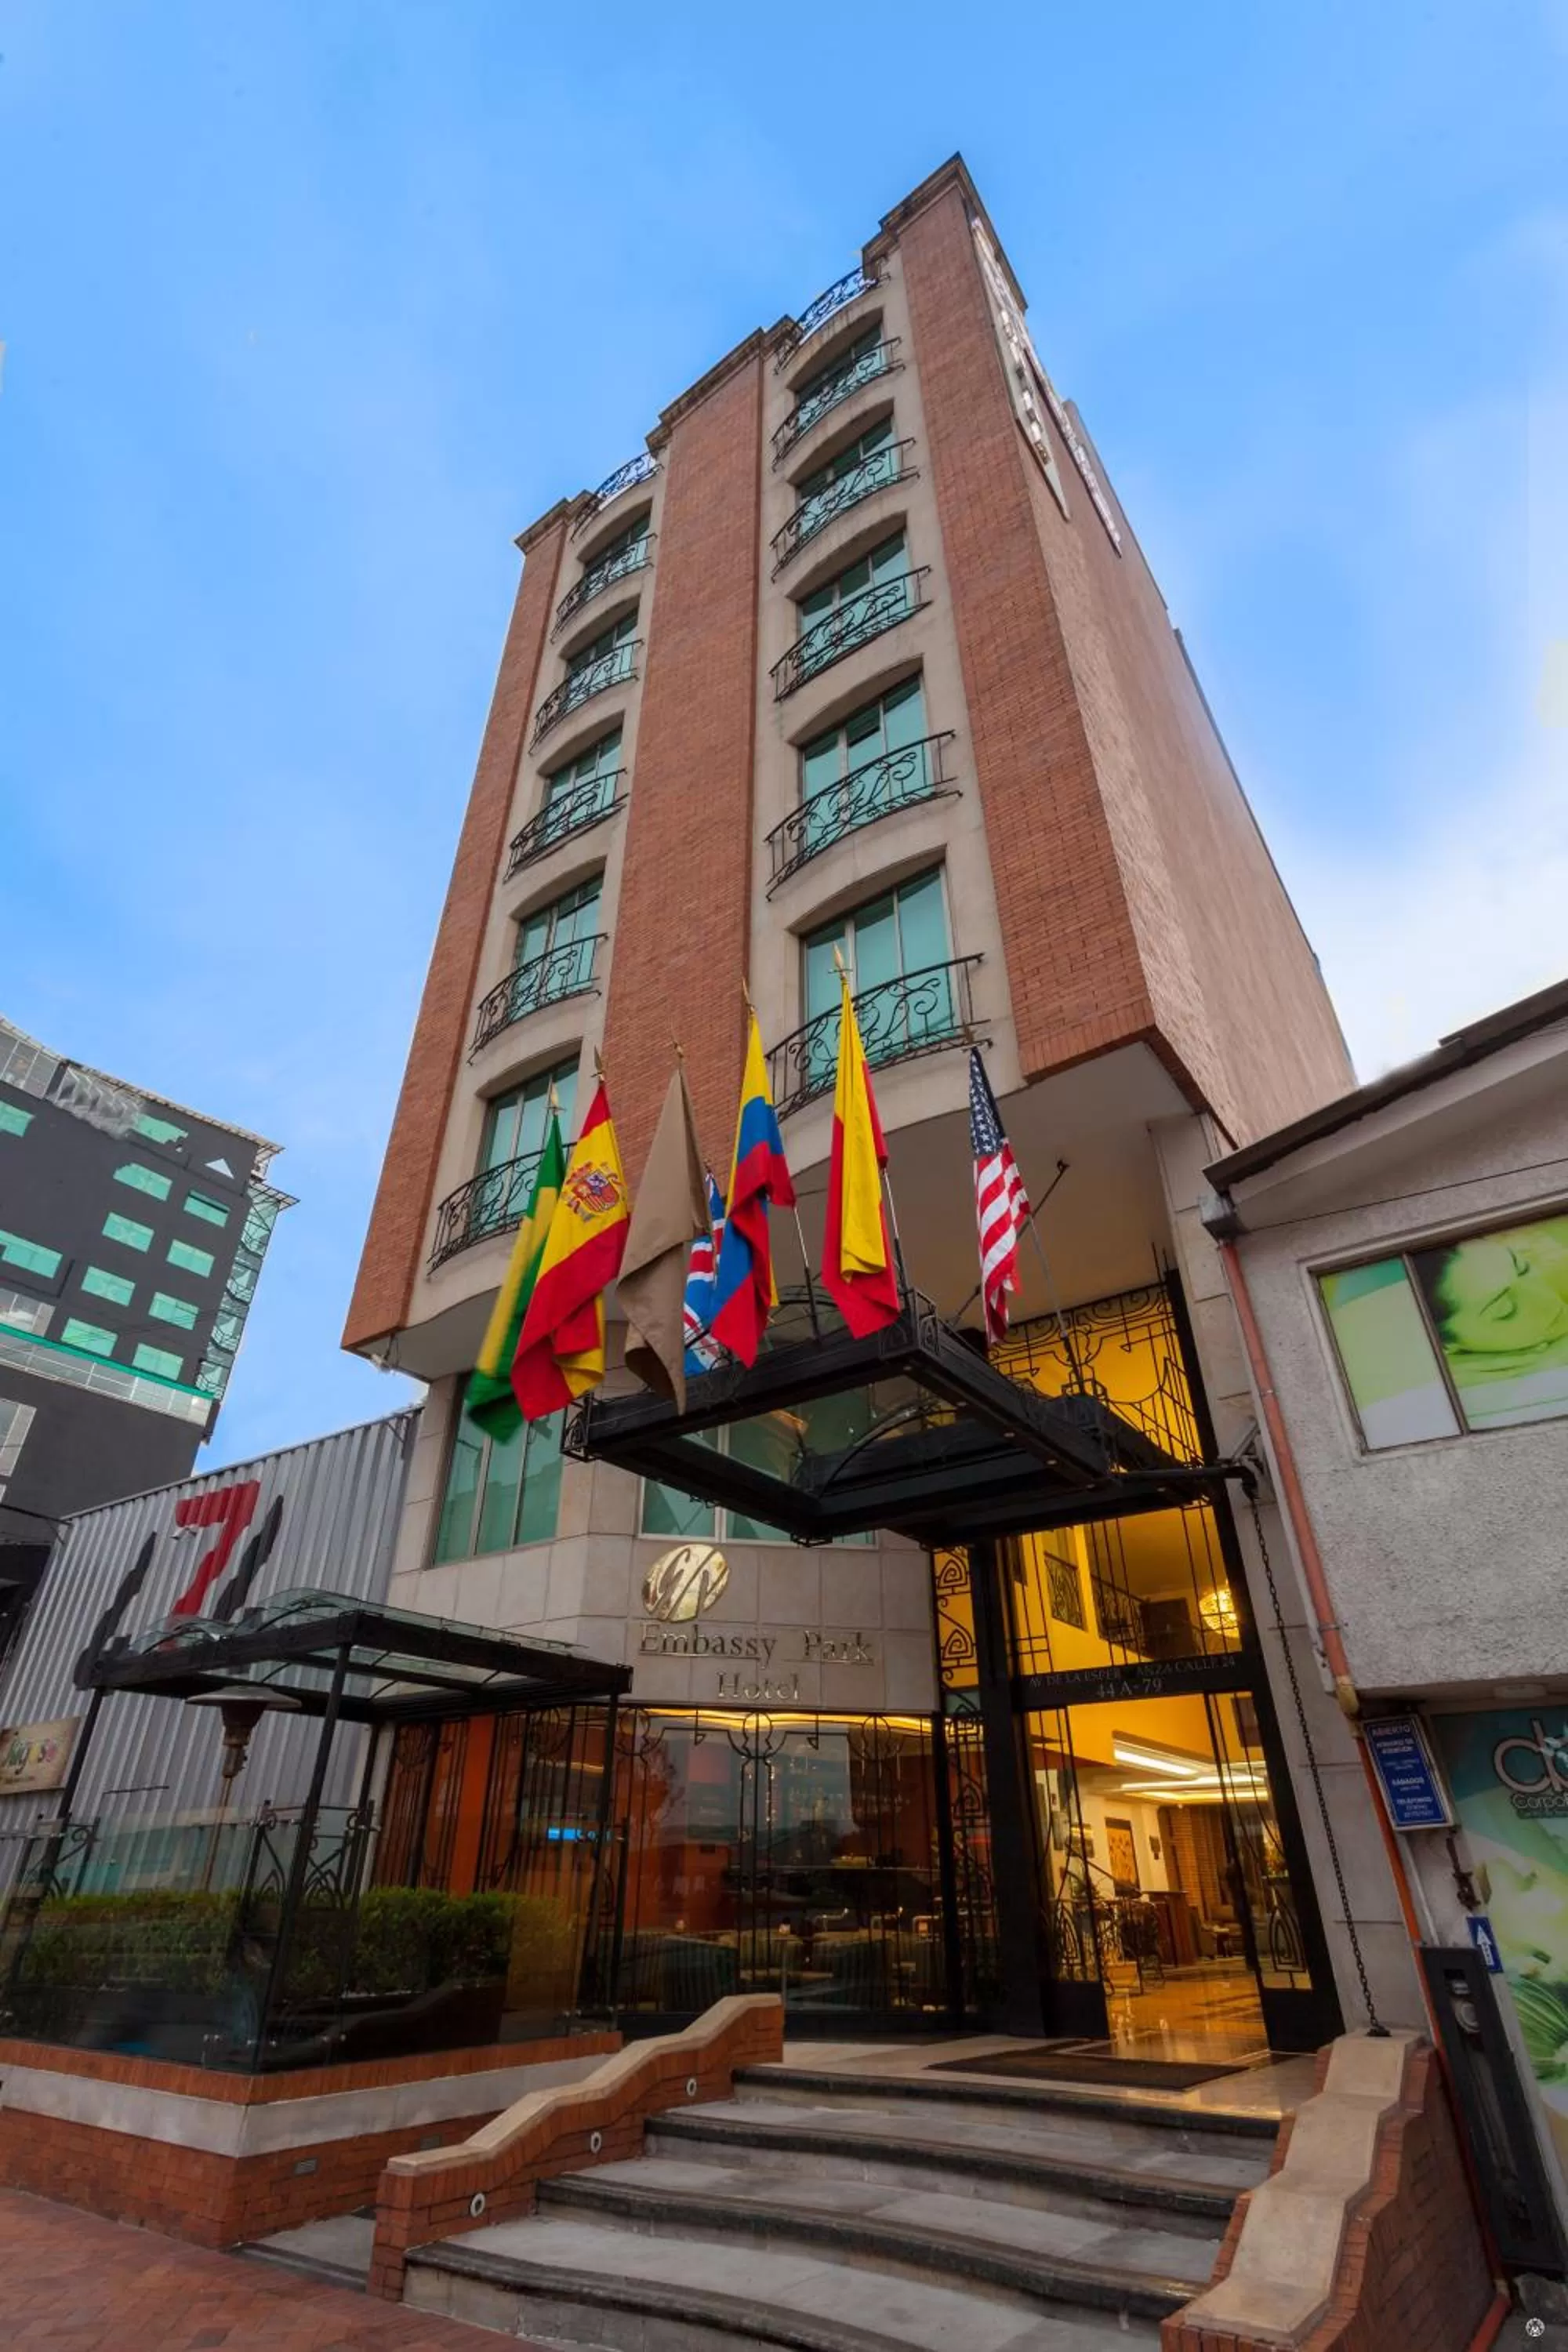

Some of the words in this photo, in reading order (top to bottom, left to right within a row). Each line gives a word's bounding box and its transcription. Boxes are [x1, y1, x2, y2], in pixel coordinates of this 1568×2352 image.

[640, 1621, 777, 1670] Embassy
[803, 1629, 873, 1664] Park
[715, 1671, 800, 1700] Hotel
